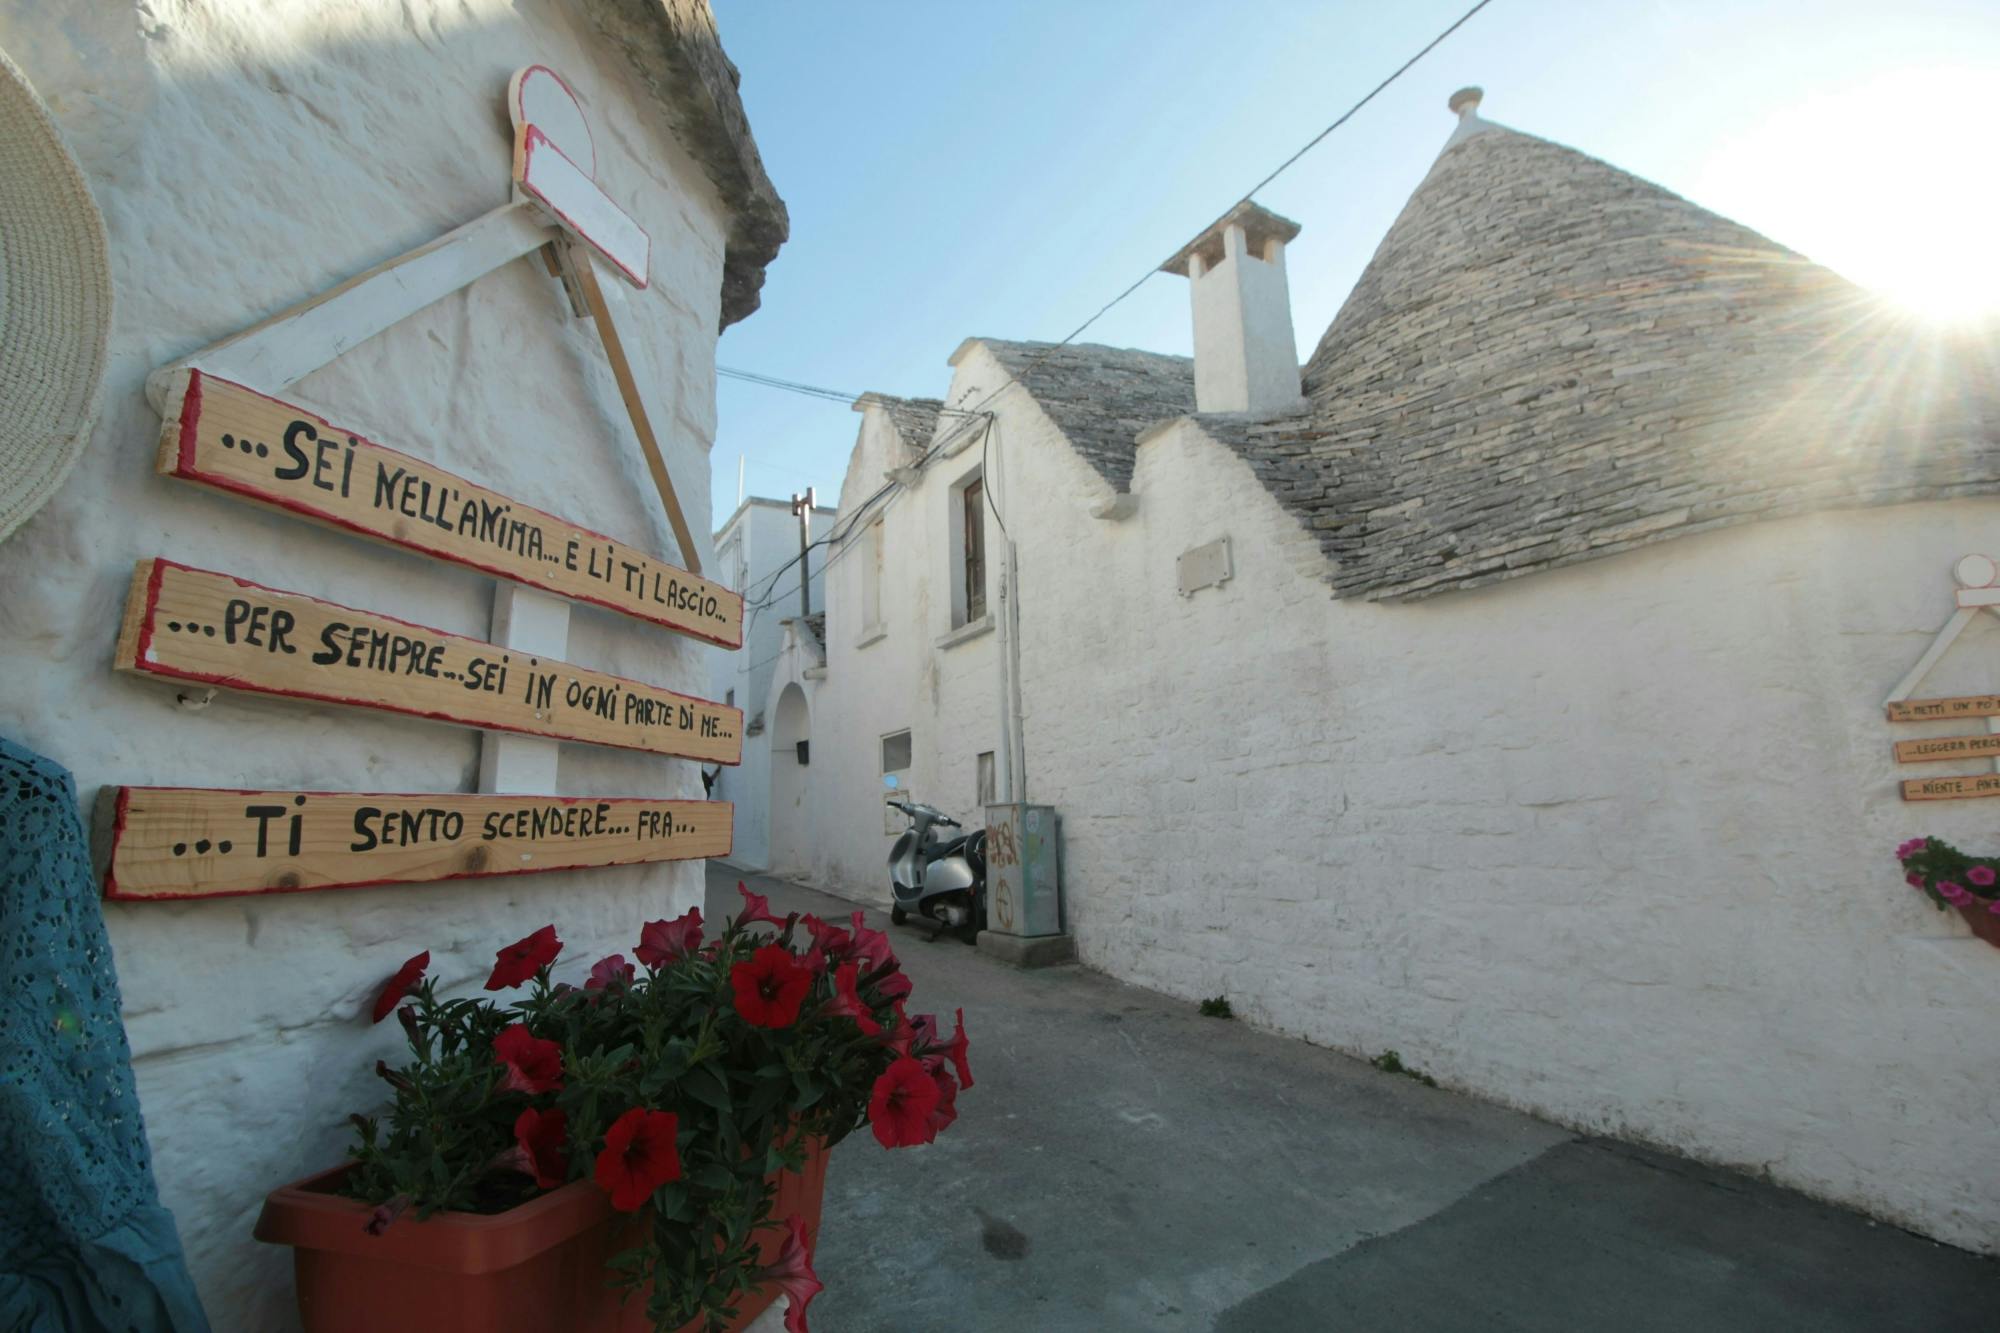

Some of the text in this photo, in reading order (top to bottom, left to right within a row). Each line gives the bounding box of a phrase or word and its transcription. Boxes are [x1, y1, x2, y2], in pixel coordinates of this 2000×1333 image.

[566, 541, 579, 571] E
[625, 693, 672, 726] PARTE
[1953, 701, 1969, 711] UN
[351, 807, 464, 852] SENTO
